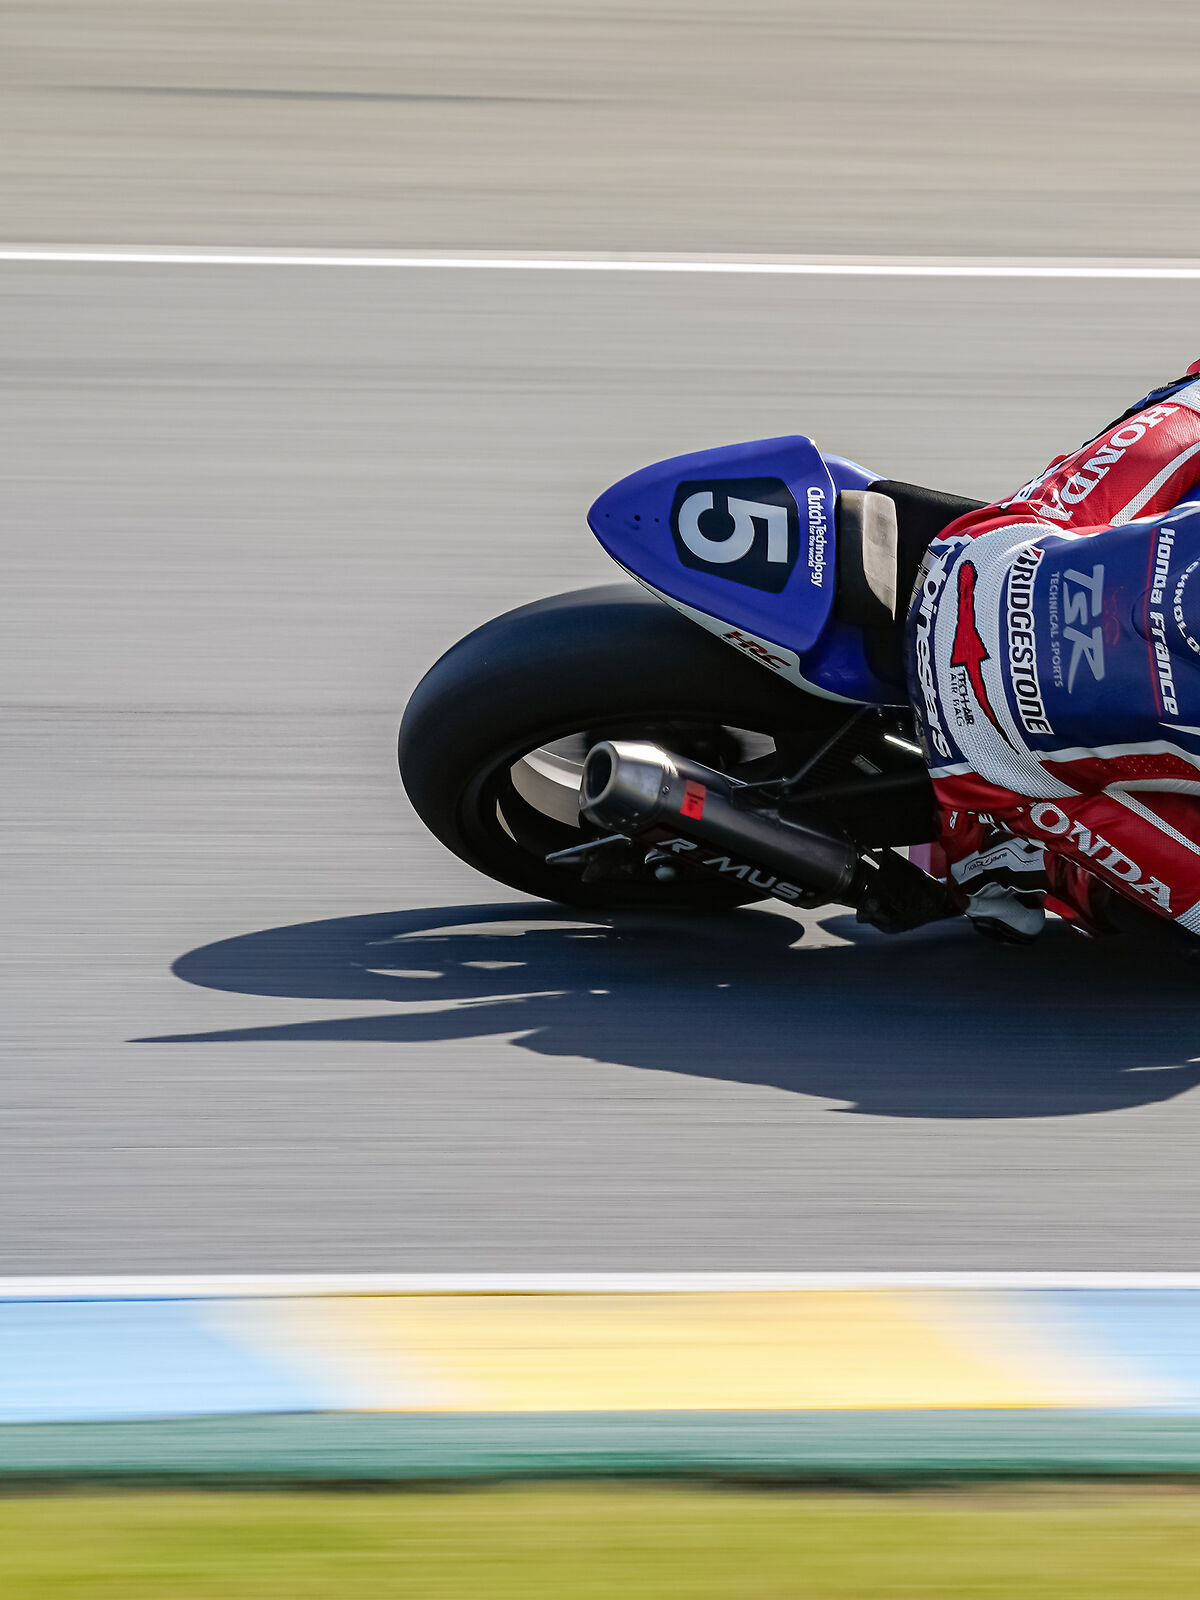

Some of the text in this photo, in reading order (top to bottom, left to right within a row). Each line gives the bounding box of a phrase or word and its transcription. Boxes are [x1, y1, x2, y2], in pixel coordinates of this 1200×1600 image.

[1038, 402, 1181, 522] HONDA
[678, 491, 788, 564] 5
[807, 487, 827, 588] Clutch Technology
[1007, 547, 1055, 736] BRIDGESTONE
[1049, 571, 1064, 689] TECHNICAL SPORTS
[1064, 564, 1106, 695] TSR
[1149, 527, 1180, 716] Honda France
[1028, 801, 1172, 913] ONDA
